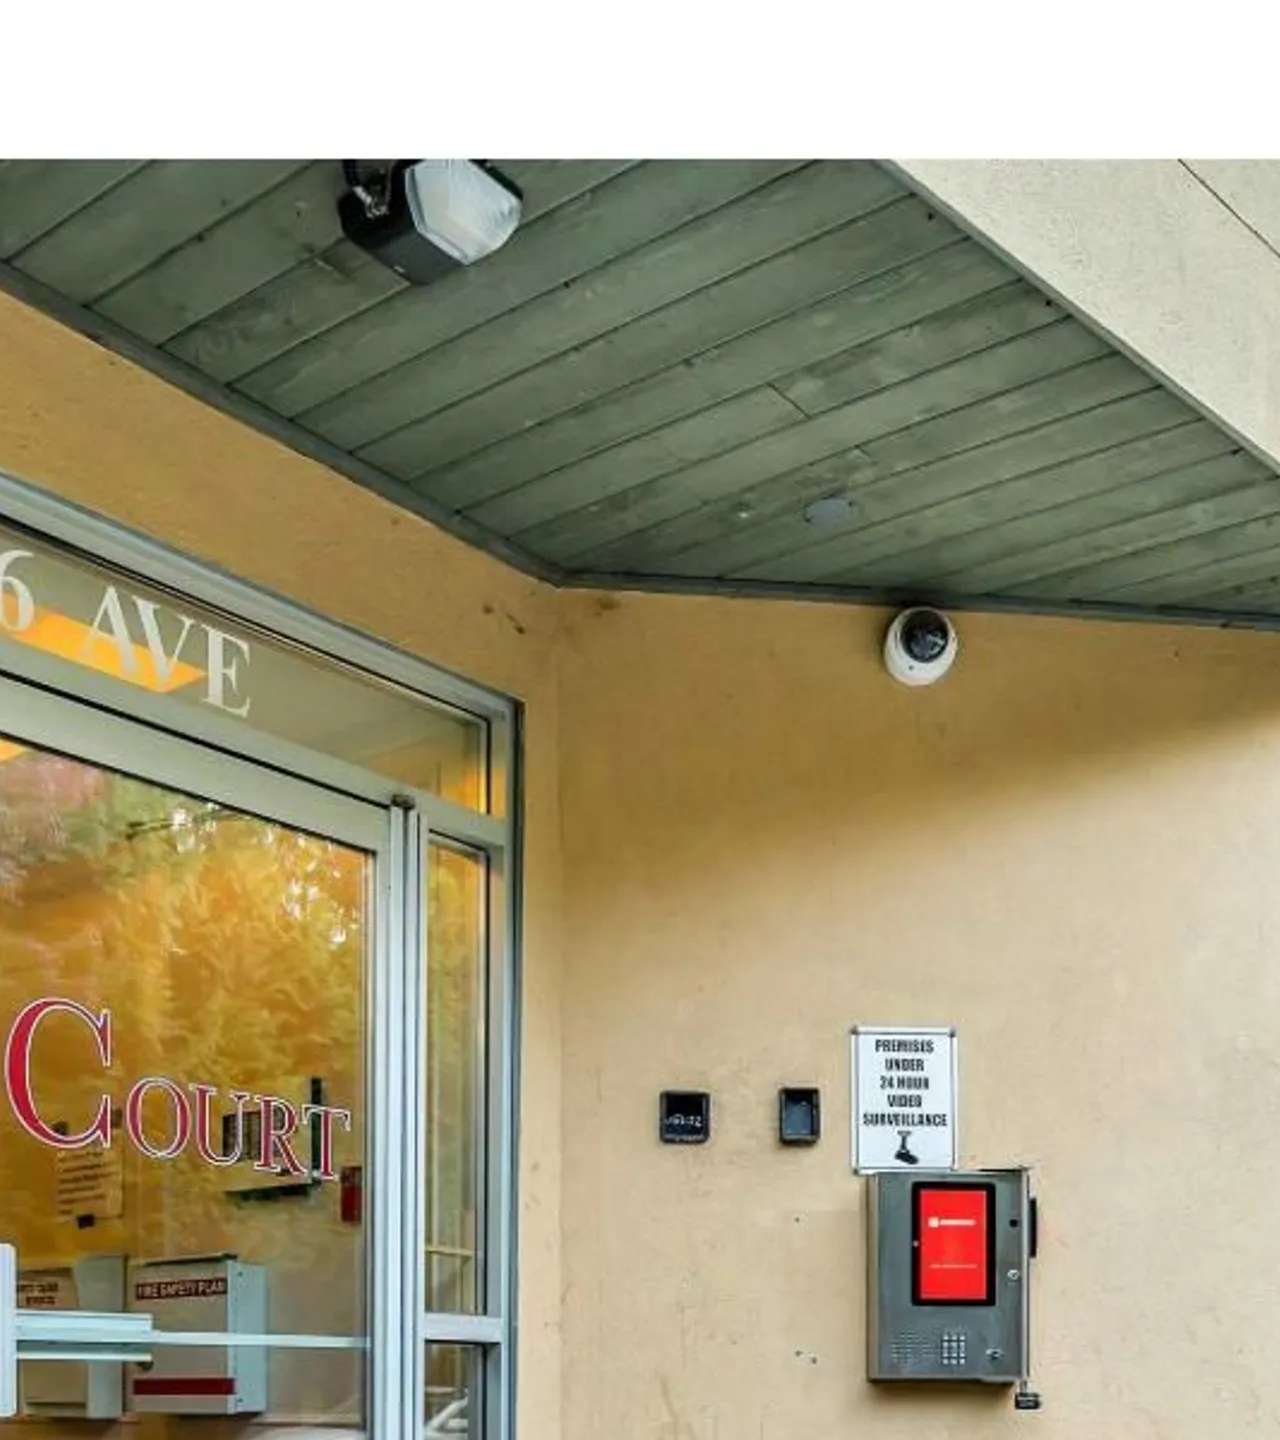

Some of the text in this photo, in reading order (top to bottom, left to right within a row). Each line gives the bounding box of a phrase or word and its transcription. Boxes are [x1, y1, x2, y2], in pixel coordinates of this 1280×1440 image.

[80, 585, 251, 718] AVE
[875, 1039, 934, 1053] PREMISES
[885, 1058, 924, 1071] UNDER
[4, 997, 351, 1180] COURT
[880, 1075, 929, 1090] 24 HOUR
[887, 1094, 922, 1108] VIDEO
[863, 1113, 948, 1127] SURVEILLANCE
